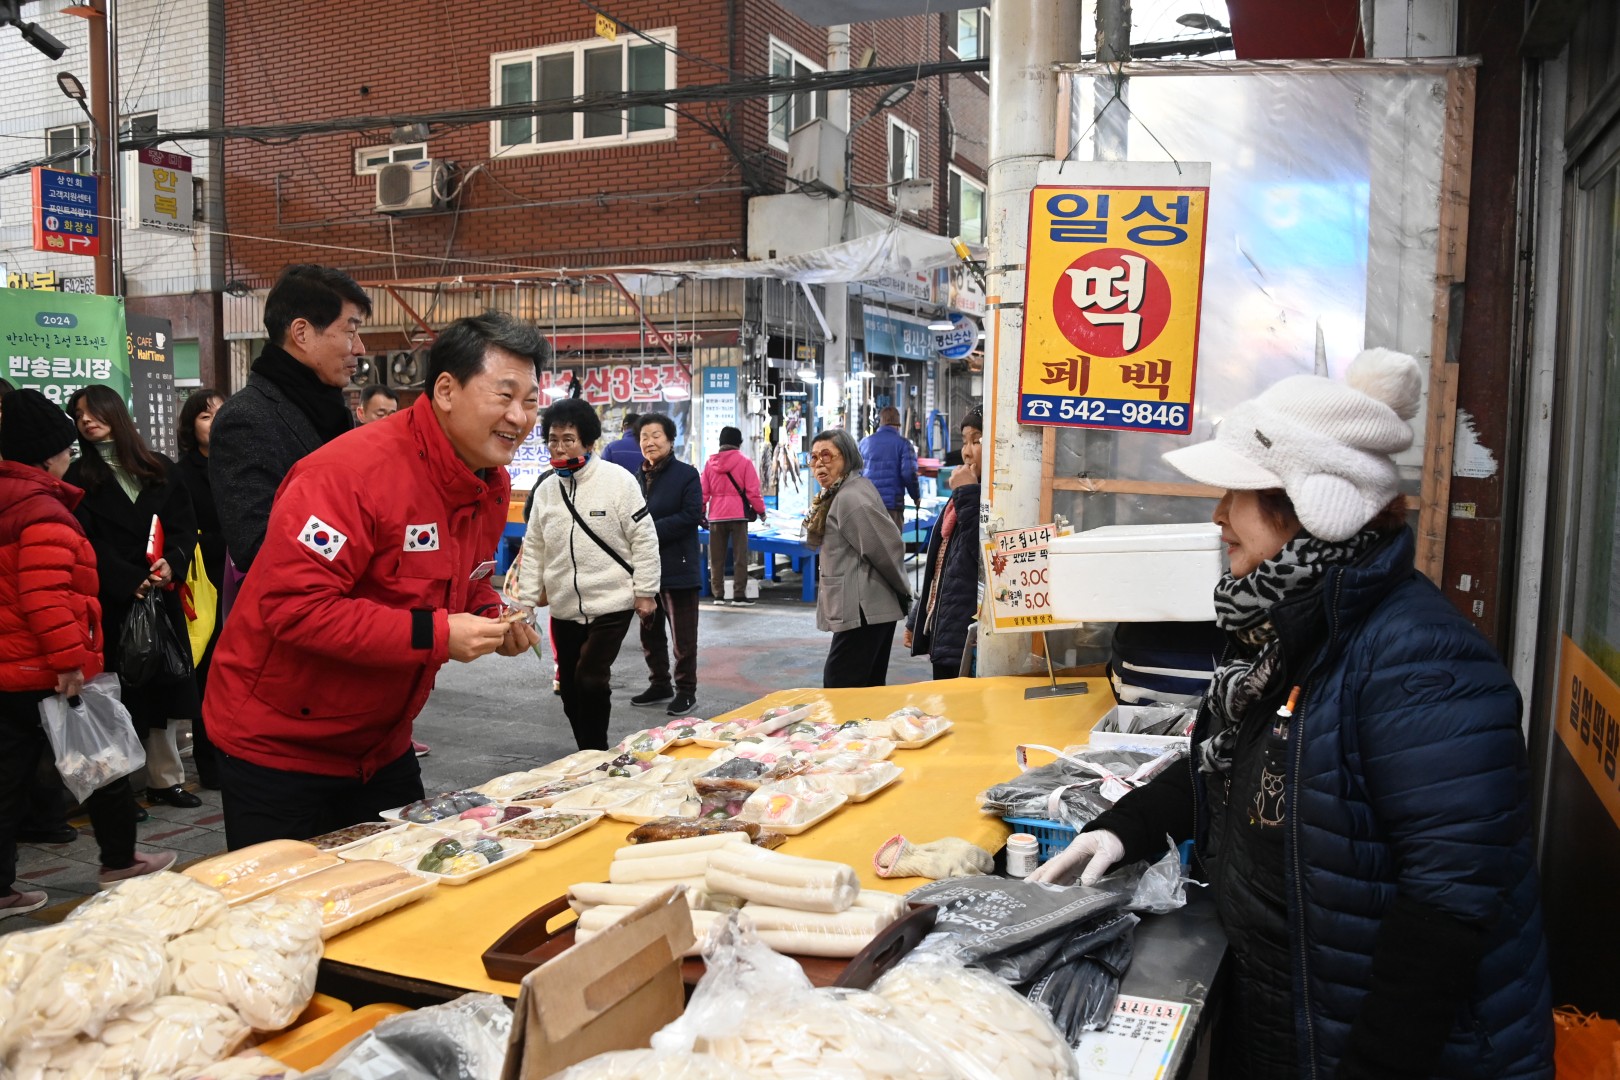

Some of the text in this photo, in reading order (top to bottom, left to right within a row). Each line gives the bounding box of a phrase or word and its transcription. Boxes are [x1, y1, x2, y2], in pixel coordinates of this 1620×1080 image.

[57, 175, 83, 187] 상인회
[48, 189, 92, 204] 고객지원센터
[152, 168, 178, 219] 한복
[63, 220, 93, 234] 화장실
[1046, 193, 1190, 247] 일성
[1065, 255, 1147, 352] 떡
[43, 316, 71, 325] 2024
[6, 332, 108, 350] 반리단길 조성 프로젝트
[935, 330, 971, 347] 명신수산
[9, 355, 112, 380] 반송큰시장
[1059, 399, 1185, 427] 542-9846
